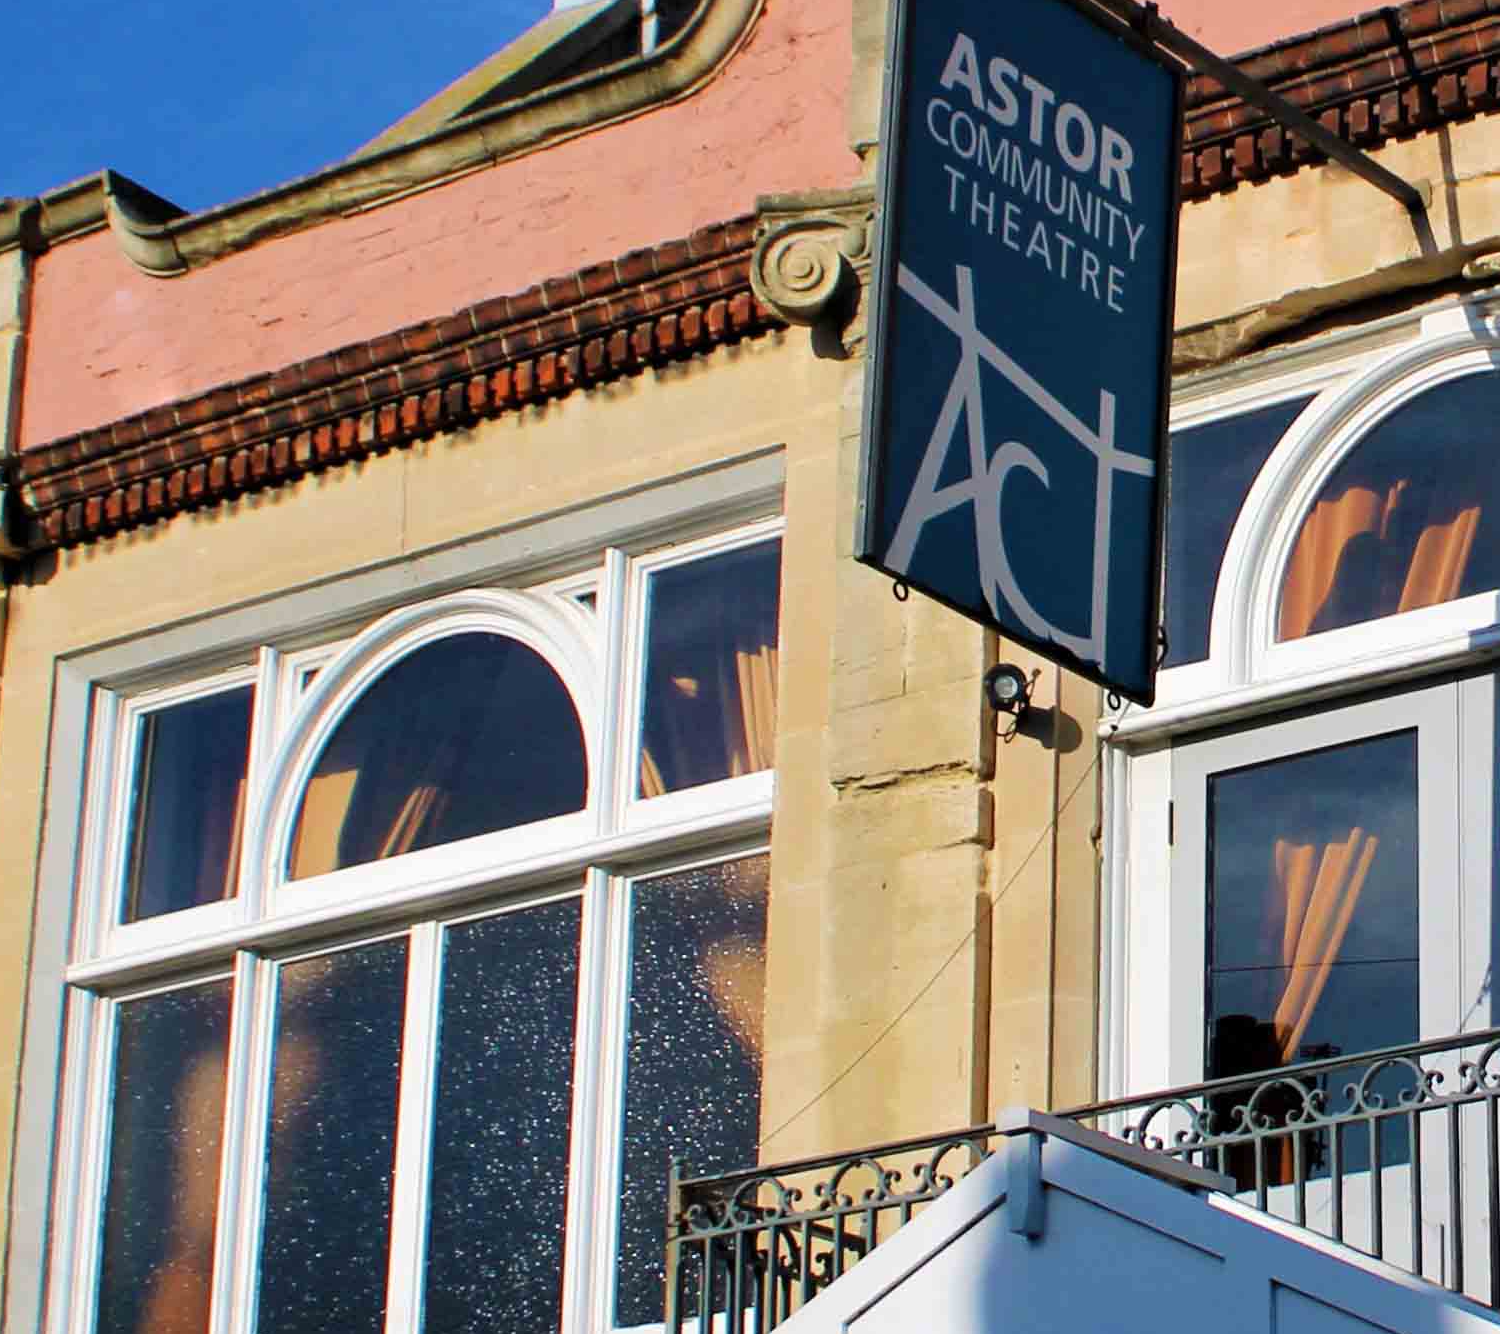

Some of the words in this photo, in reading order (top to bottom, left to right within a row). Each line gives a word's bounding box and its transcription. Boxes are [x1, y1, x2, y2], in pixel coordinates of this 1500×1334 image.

[927, 98, 1145, 262] COMMUNITY
[940, 33, 1133, 204] ASTOR
[944, 164, 1125, 313] THEATRE
